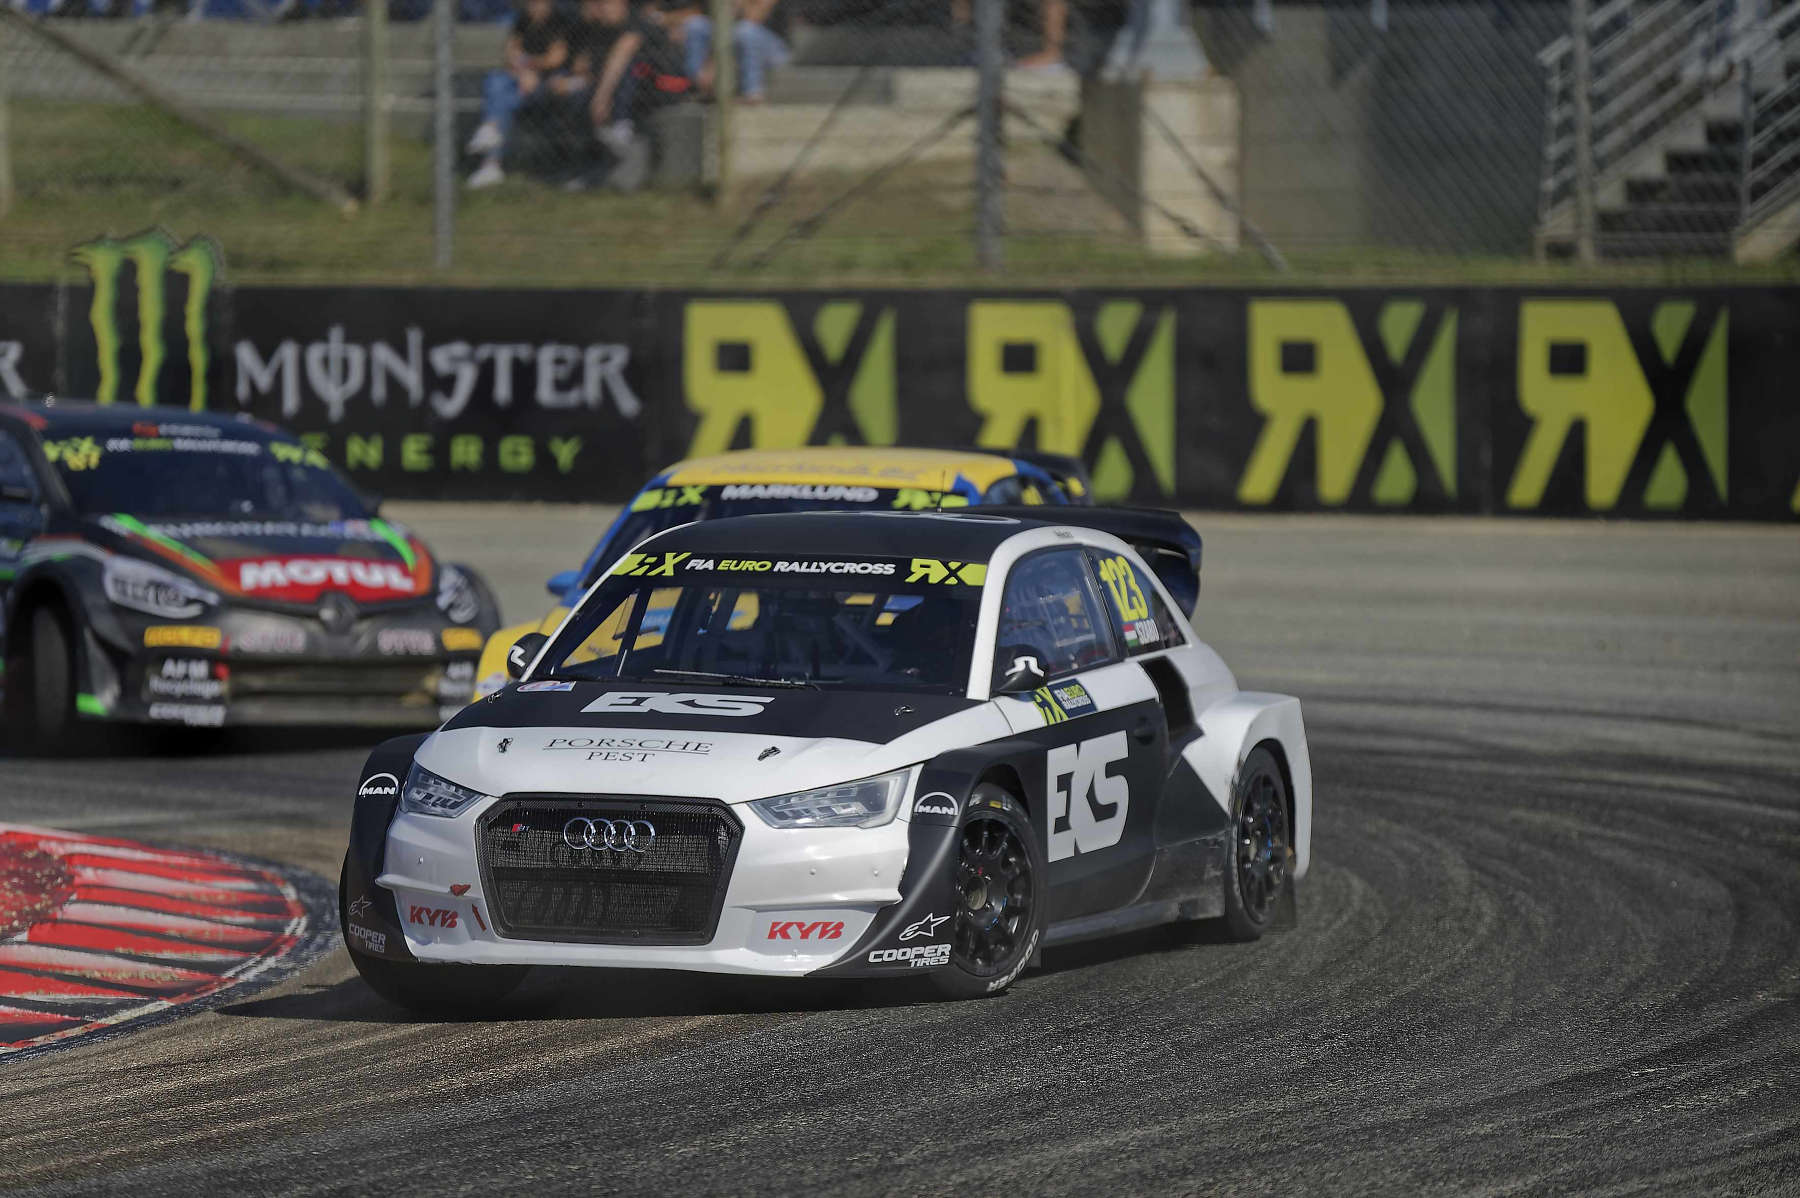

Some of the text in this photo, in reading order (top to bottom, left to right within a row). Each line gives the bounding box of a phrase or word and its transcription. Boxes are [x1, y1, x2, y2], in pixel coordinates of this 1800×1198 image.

[234, 324, 642, 422] MONSTER
[721, 484, 879, 502] MARKLUND
[240, 561, 415, 591] MOTUL
[685, 559, 896, 576] FIA EURO RALLYCROSS
[1099, 556, 1148, 622] 123
[580, 691, 775, 717] EKS
[548, 737, 713, 752] PORSCHE
[585, 751, 656, 762] PEST
[1047, 730, 1129, 863] EKS
[409, 904, 460, 929] KYB
[349, 922, 386, 945] COOPER
[767, 921, 845, 940] KYB
[868, 943, 952, 963] COOPER
[909, 955, 949, 968] TIRES
